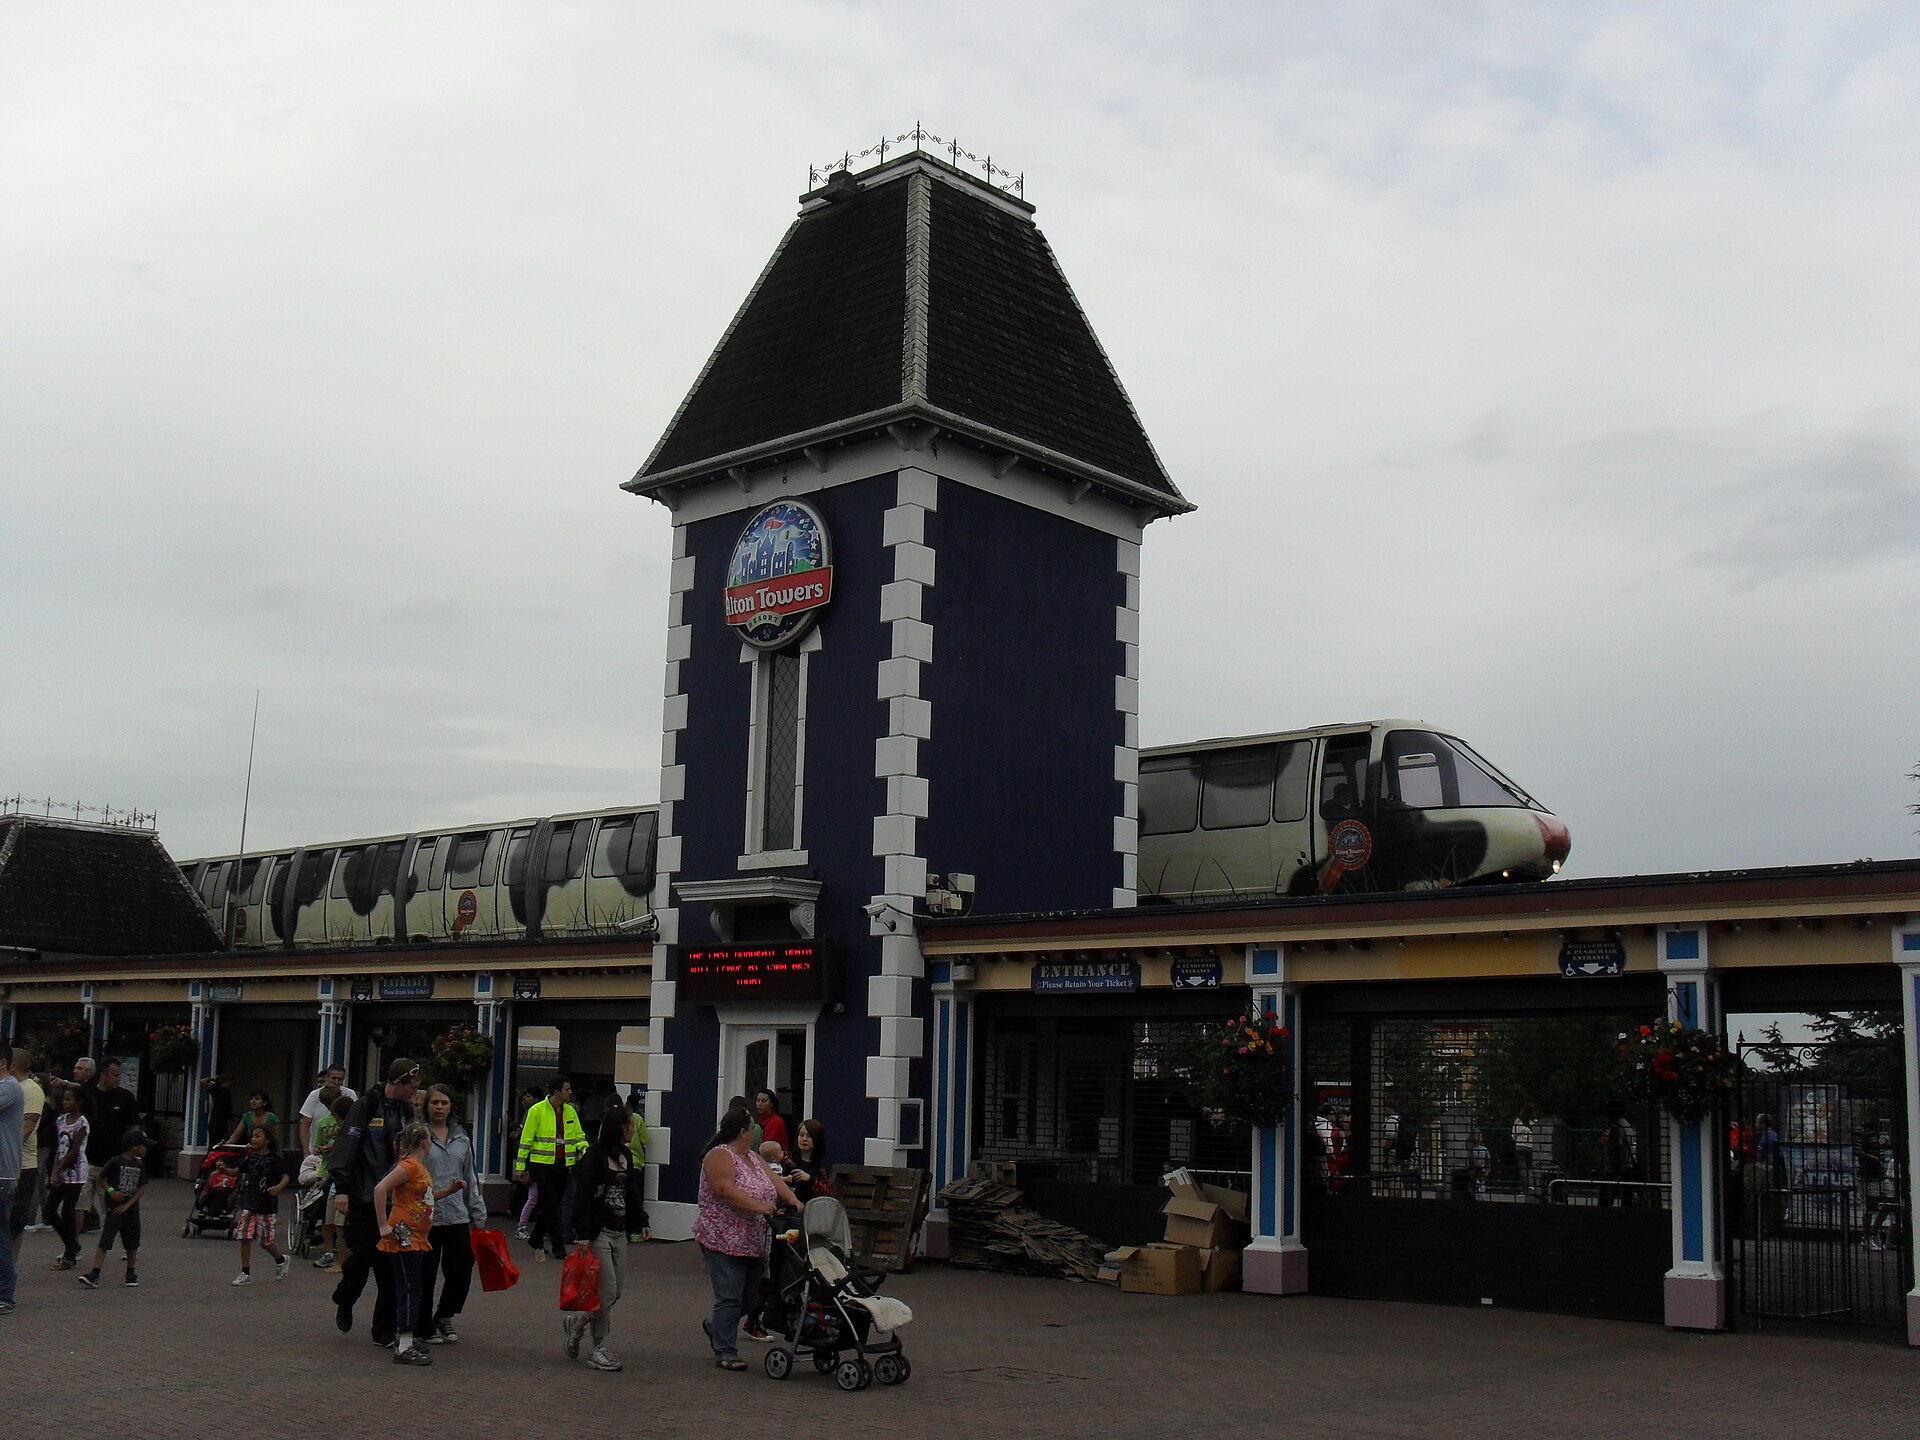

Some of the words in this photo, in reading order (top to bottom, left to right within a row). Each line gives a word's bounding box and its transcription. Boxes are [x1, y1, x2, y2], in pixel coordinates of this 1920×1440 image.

[725, 594, 756, 617] Alton
[755, 583, 824, 609] Towers
[1040, 963, 1130, 978] ENTRANCE
[1042, 980, 1063, 989] Please
[1064, 980, 1087, 988] Retain
[1087, 979, 1104, 988] Your
[1105, 978, 1128, 987] Ticket
